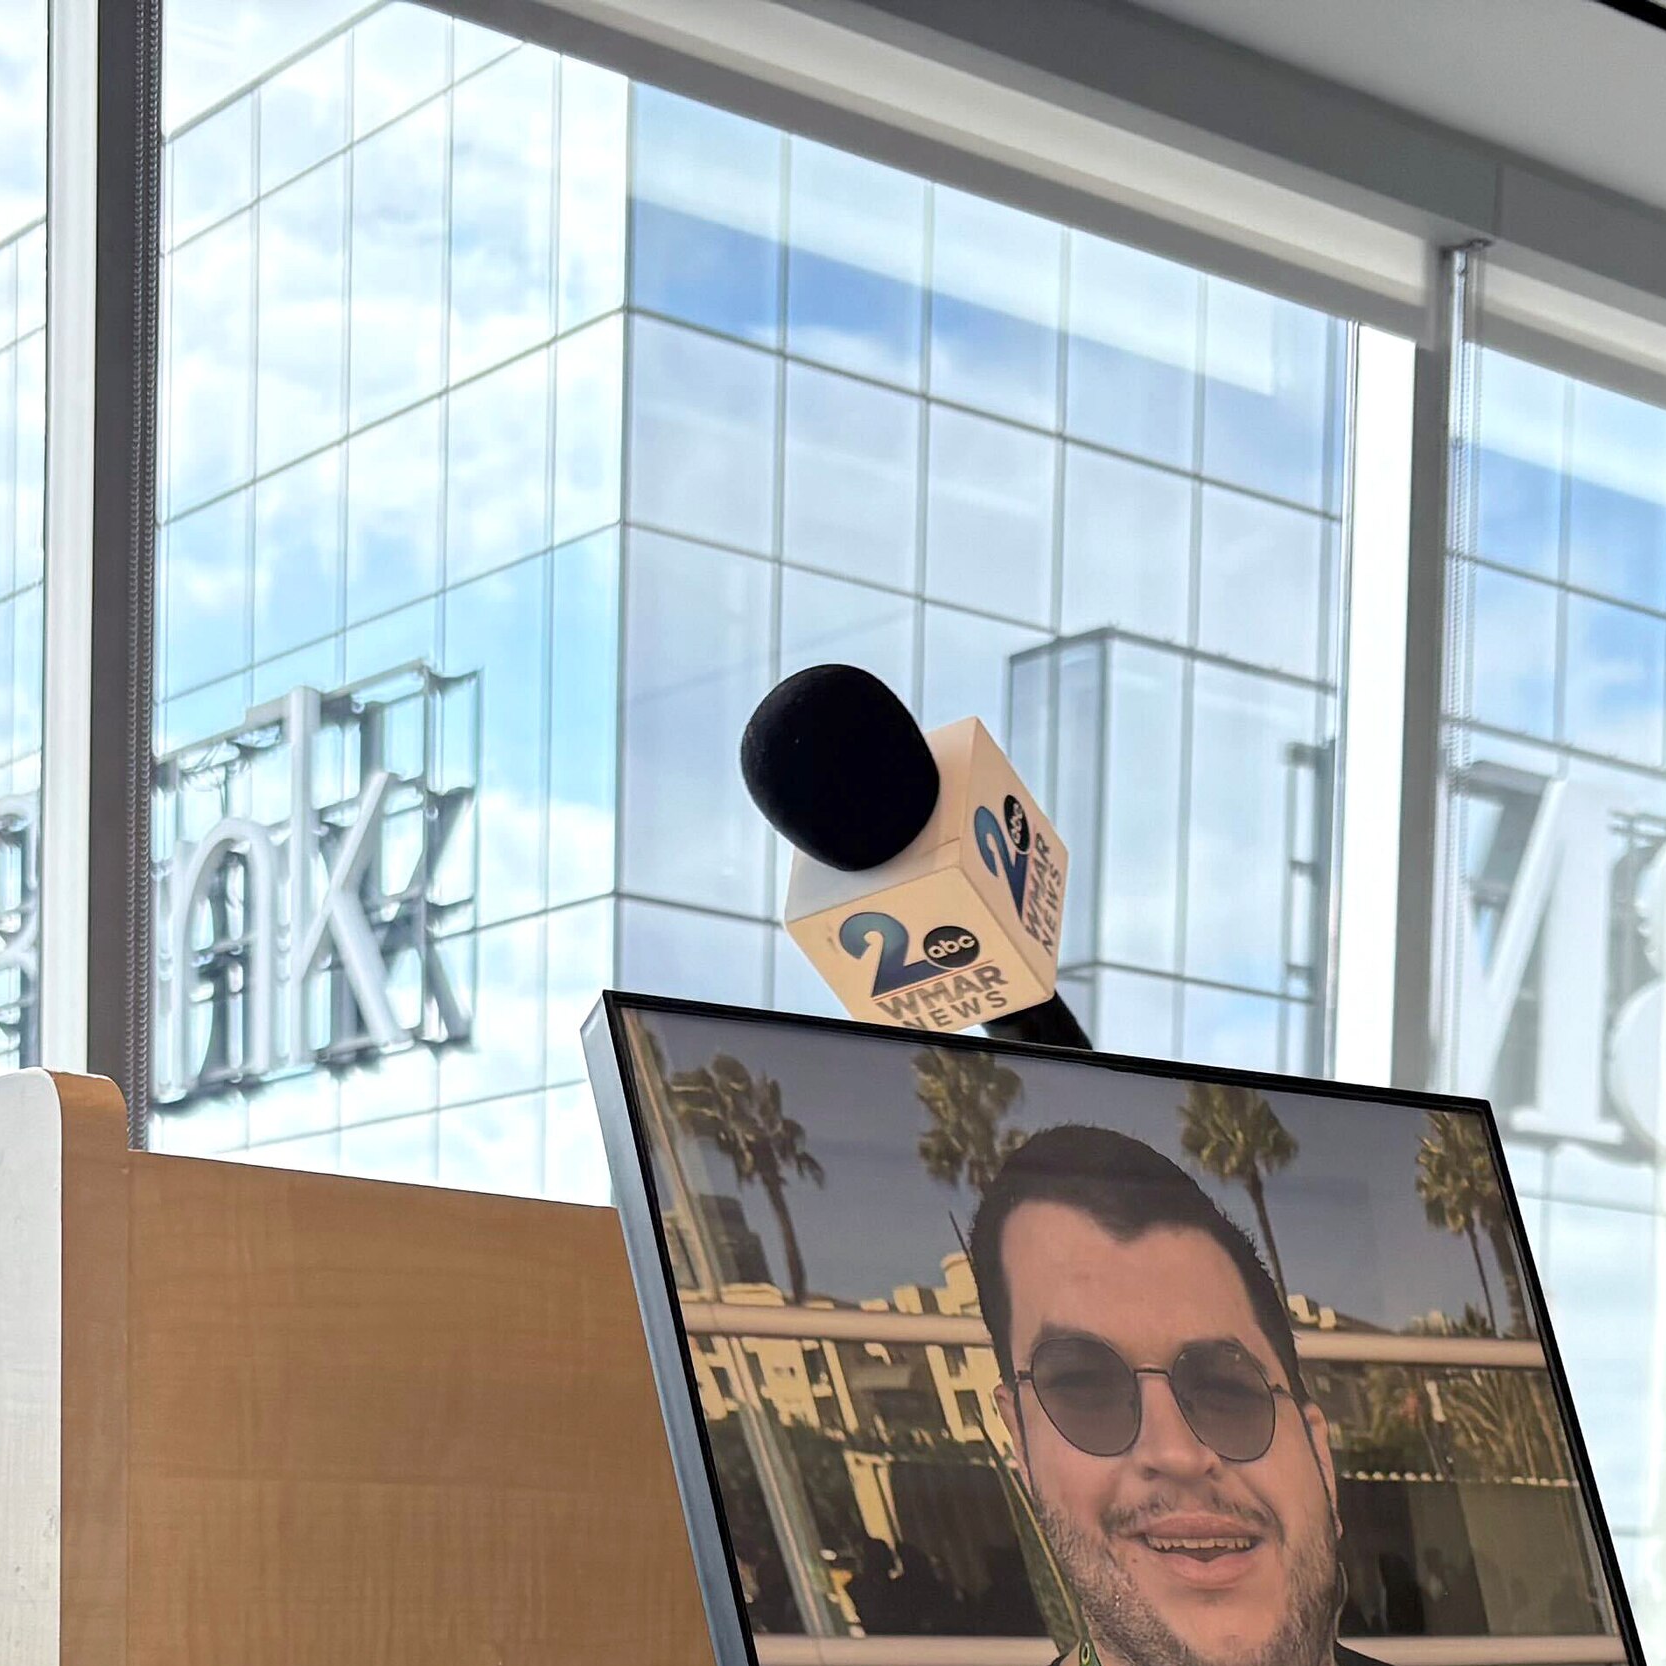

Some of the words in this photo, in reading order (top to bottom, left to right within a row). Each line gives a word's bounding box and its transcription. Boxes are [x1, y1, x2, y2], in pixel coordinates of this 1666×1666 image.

[974, 805, 1029, 922] 2
[1025, 832, 1051, 943] WMAR
[839, 911, 955, 998] 2
[928, 935, 976, 960] abc
[1041, 862, 1063, 957] NEWS
[875, 965, 1009, 1021] WMAR
[902, 990, 1008, 1032] NEWS
